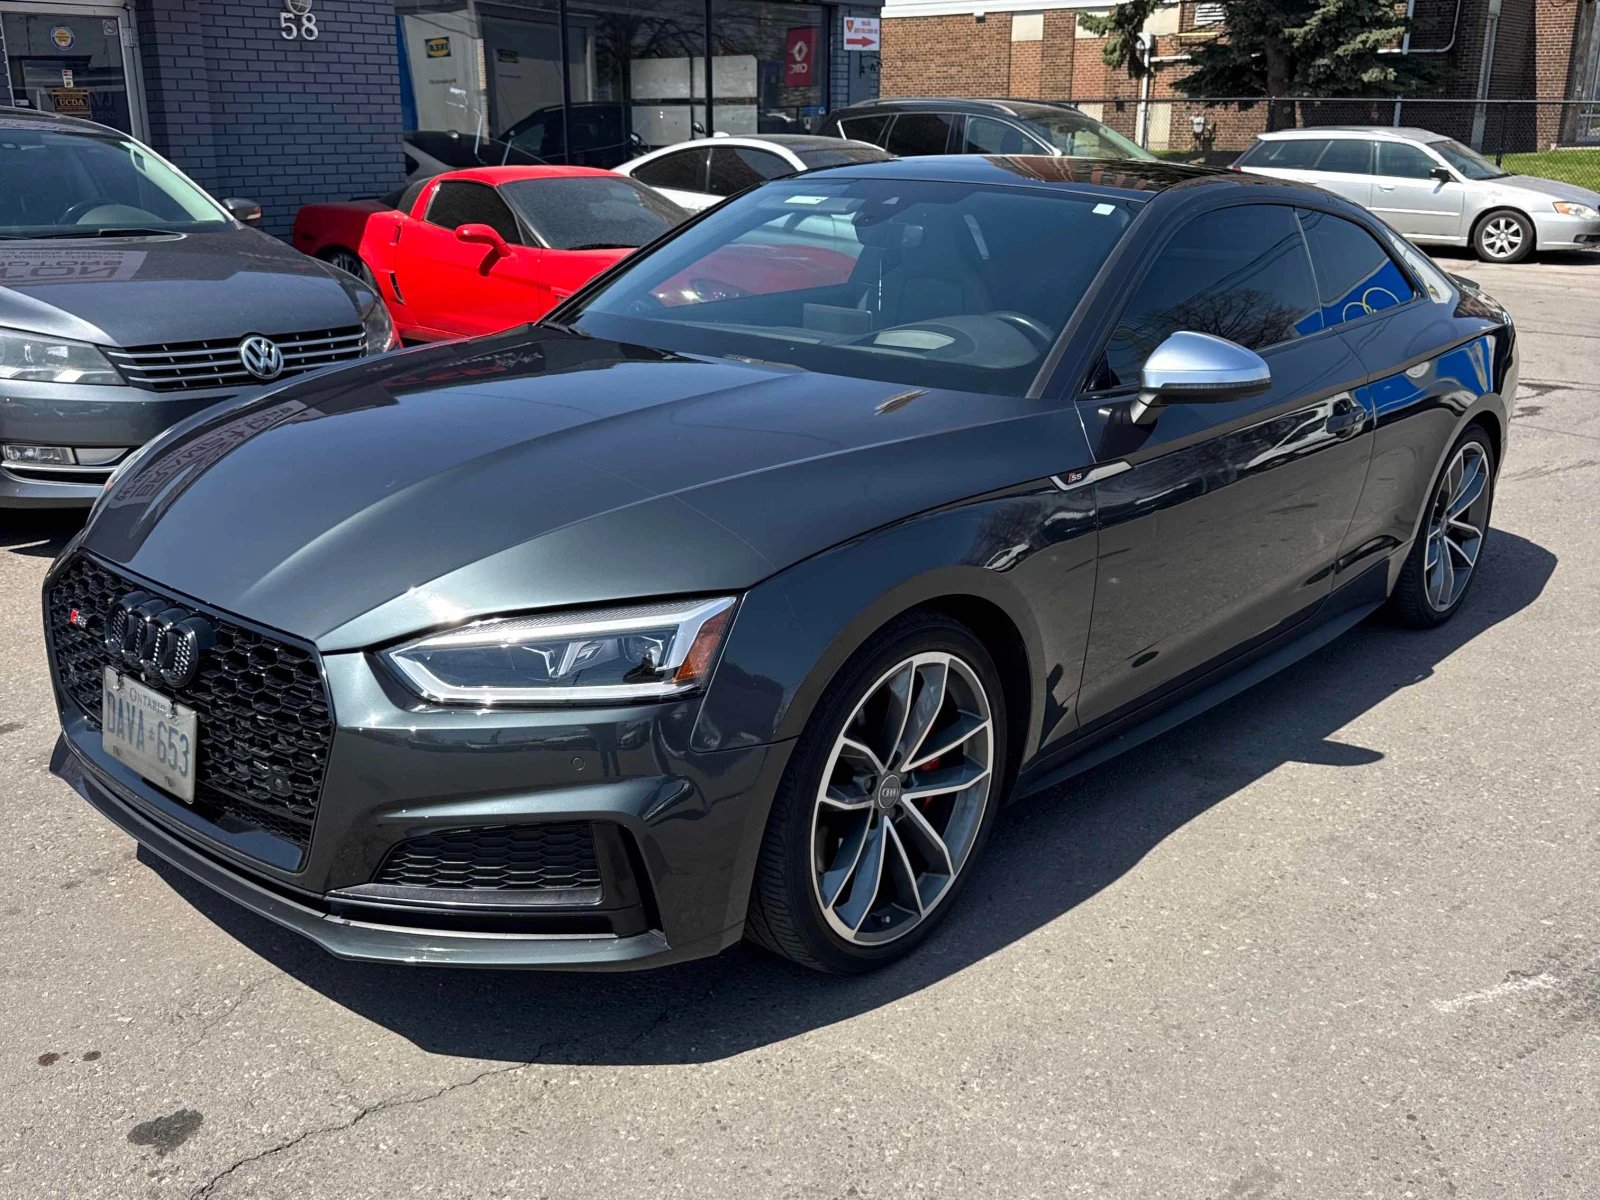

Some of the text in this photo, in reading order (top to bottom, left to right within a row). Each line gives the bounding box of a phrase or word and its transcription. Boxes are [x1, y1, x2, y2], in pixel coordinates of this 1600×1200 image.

[280, 12, 319, 40] 58
[59, 98, 85, 106] UCDA
[241, 336, 284, 379] VW
[107, 691, 145, 750] DAVA
[157, 720, 190, 778] 653
